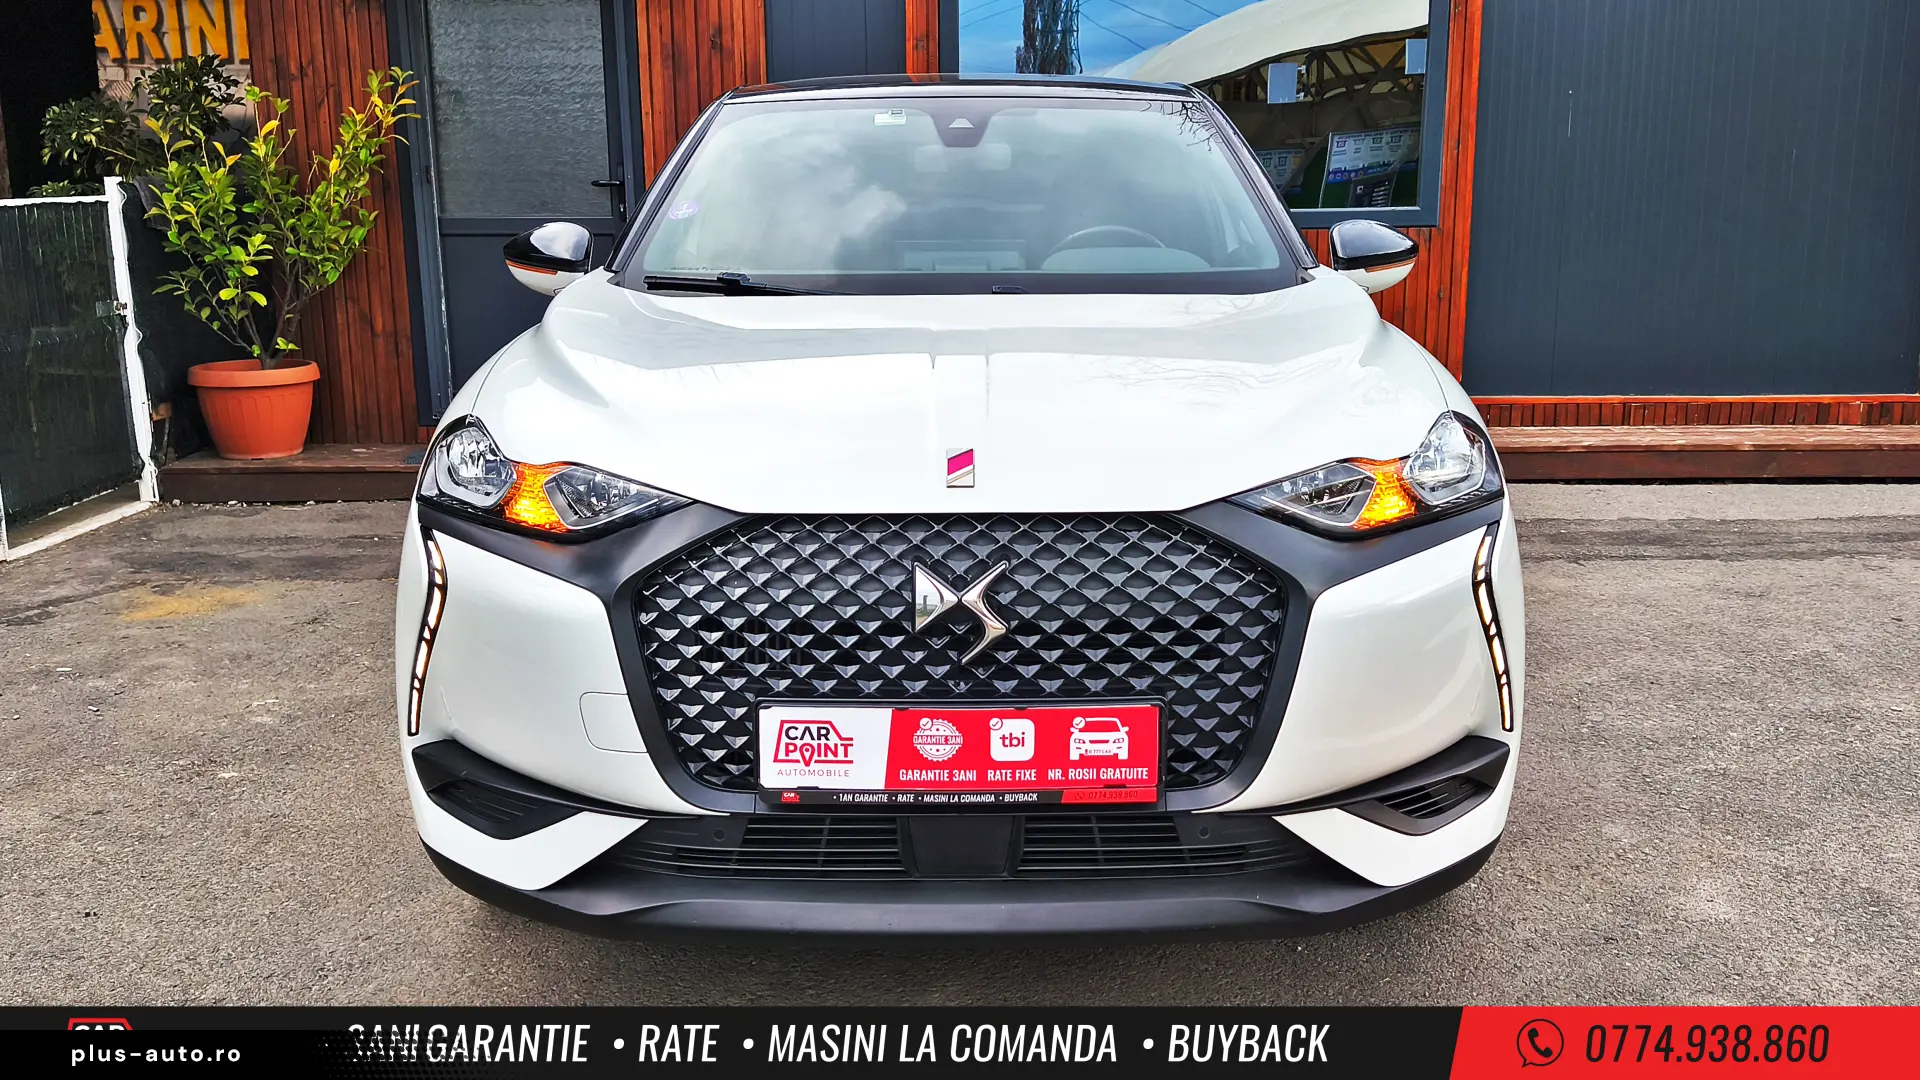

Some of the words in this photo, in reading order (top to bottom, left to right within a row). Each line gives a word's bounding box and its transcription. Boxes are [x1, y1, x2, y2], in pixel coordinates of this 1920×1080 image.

[784, 726, 830, 741] CAR
[999, 731, 1026, 748] tbi
[913, 735, 946, 745] GARANTIE
[947, 735, 964, 745] 3ANI
[785, 742, 853, 766] POINT
[777, 769, 850, 777] AUTOMOBILE
[899, 769, 949, 781] GARANTIE
[952, 769, 977, 781] 3ANI
[987, 769, 1012, 781] RATE
[1015, 769, 1037, 781] FIXE
[1047, 768, 1066, 781] NR.
[1068, 768, 1097, 780] ROSII
[1099, 767, 1149, 780] GRATUITE
[839, 793, 853, 802] 1AN
[854, 793, 888, 802] GARANTIE
[897, 794, 915, 802] RATE
[923, 794, 949, 803] MASINI
[949, 794, 959, 802] LA
[960, 794, 996, 803] COMANDA
[1004, 793, 1039, 802] BUYBACK
